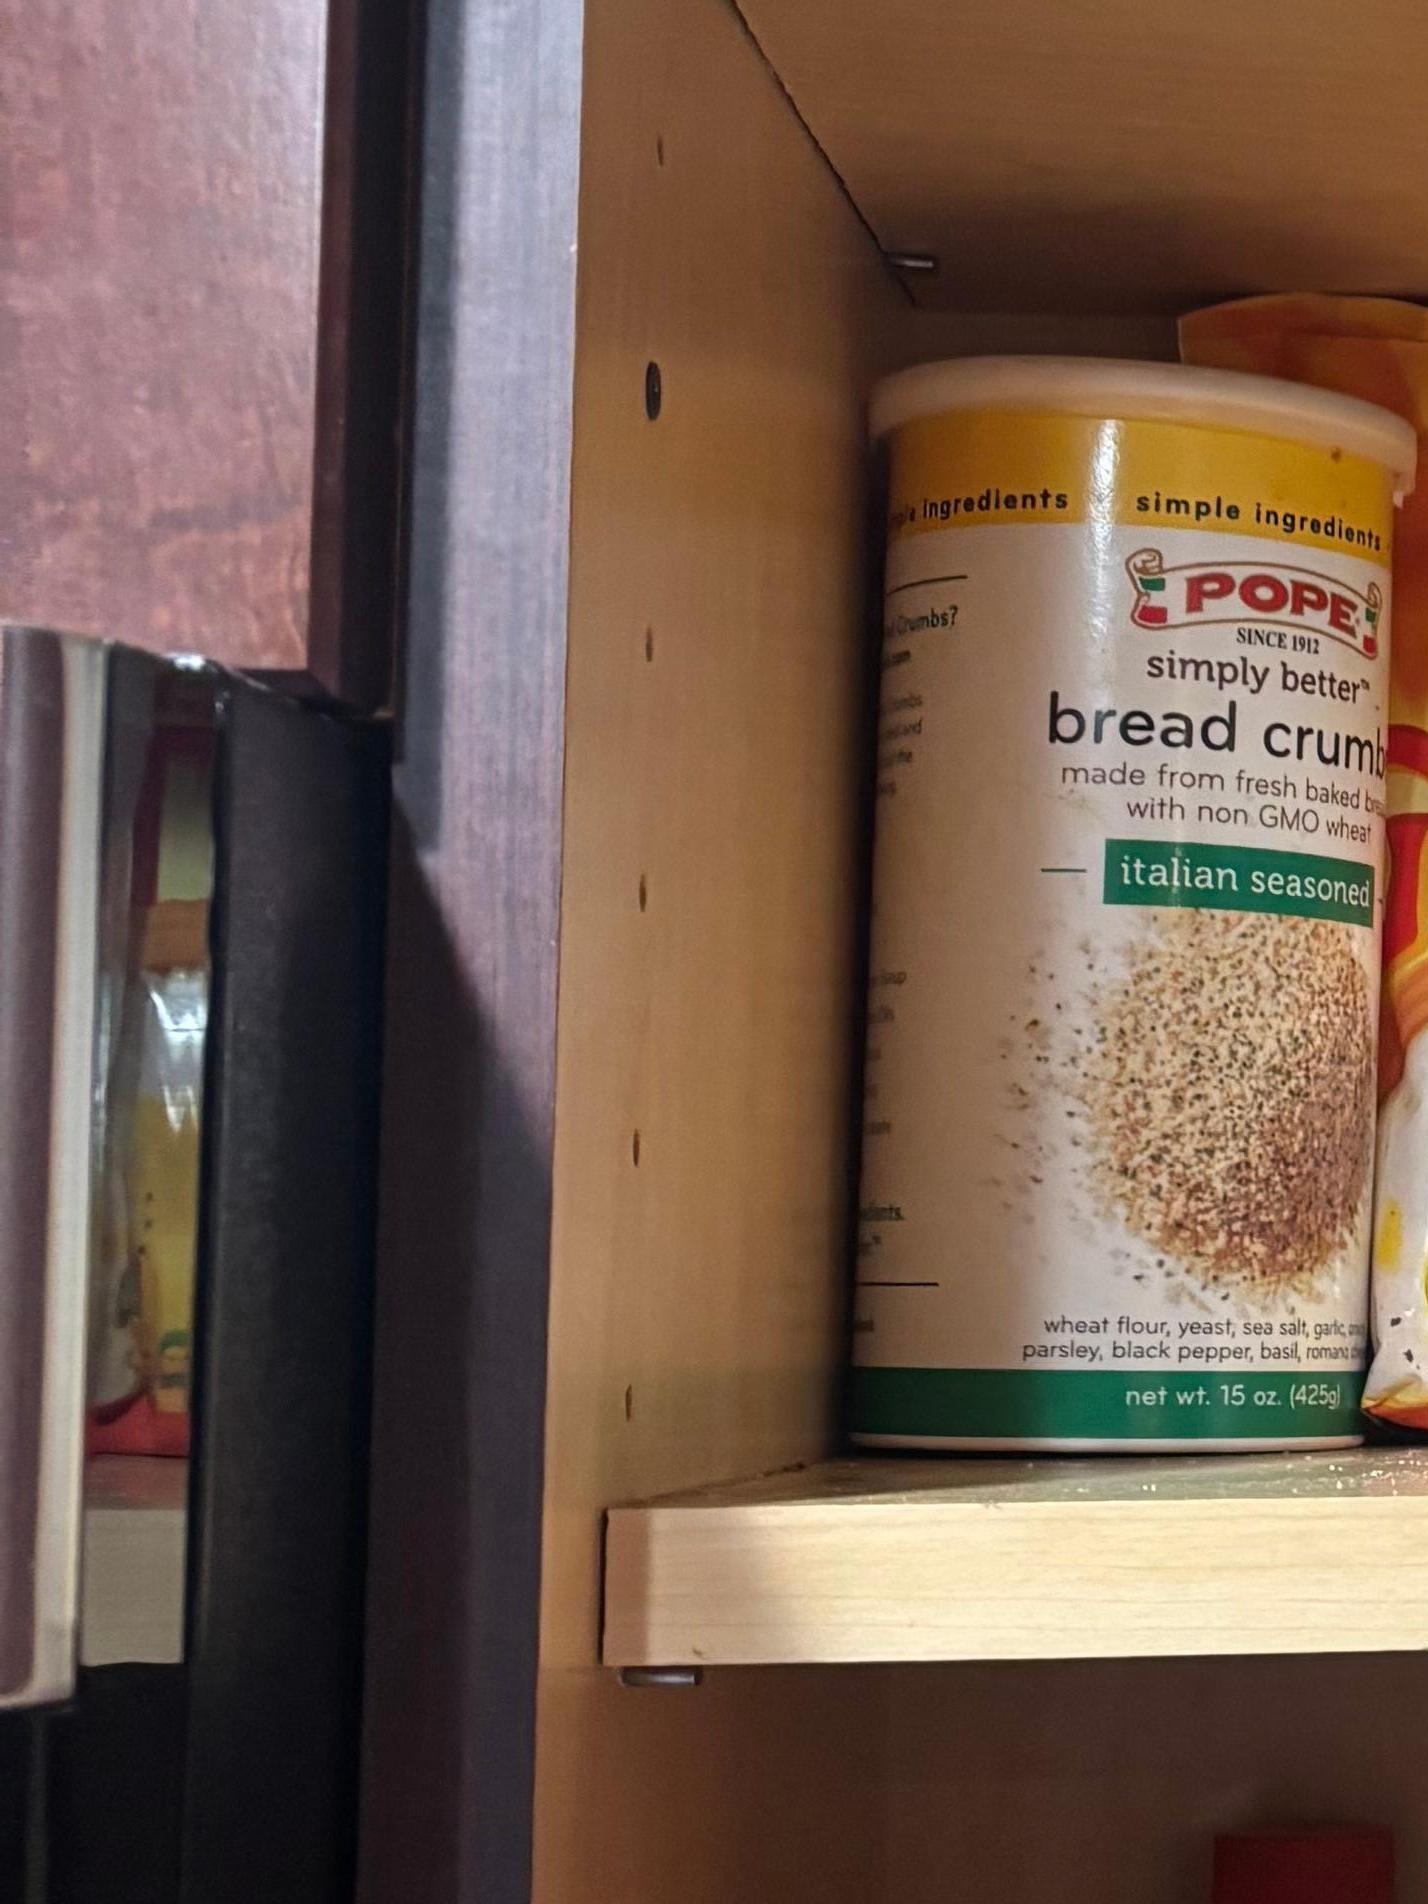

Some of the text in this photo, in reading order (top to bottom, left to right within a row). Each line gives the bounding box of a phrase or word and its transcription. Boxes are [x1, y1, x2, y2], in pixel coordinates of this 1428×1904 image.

[1137, 492, 1382, 551] simple ingredients
[1185, 572, 1357, 637] POPE
[1237, 627, 1320, 654] SINCE 1912
[1147, 650, 1269, 694] simply
[1049, 691, 1386, 780] bread crumb
[1061, 761, 1360, 809] made from fresh baked
[1127, 797, 1371, 844] with non GMO wheat
[1121, 856, 1370, 908] italian seasoned
[1045, 1316, 1273, 1336] wheat sea
[1112, 1340, 1170, 1360] black
[1125, 1384, 1246, 1407] net 15
